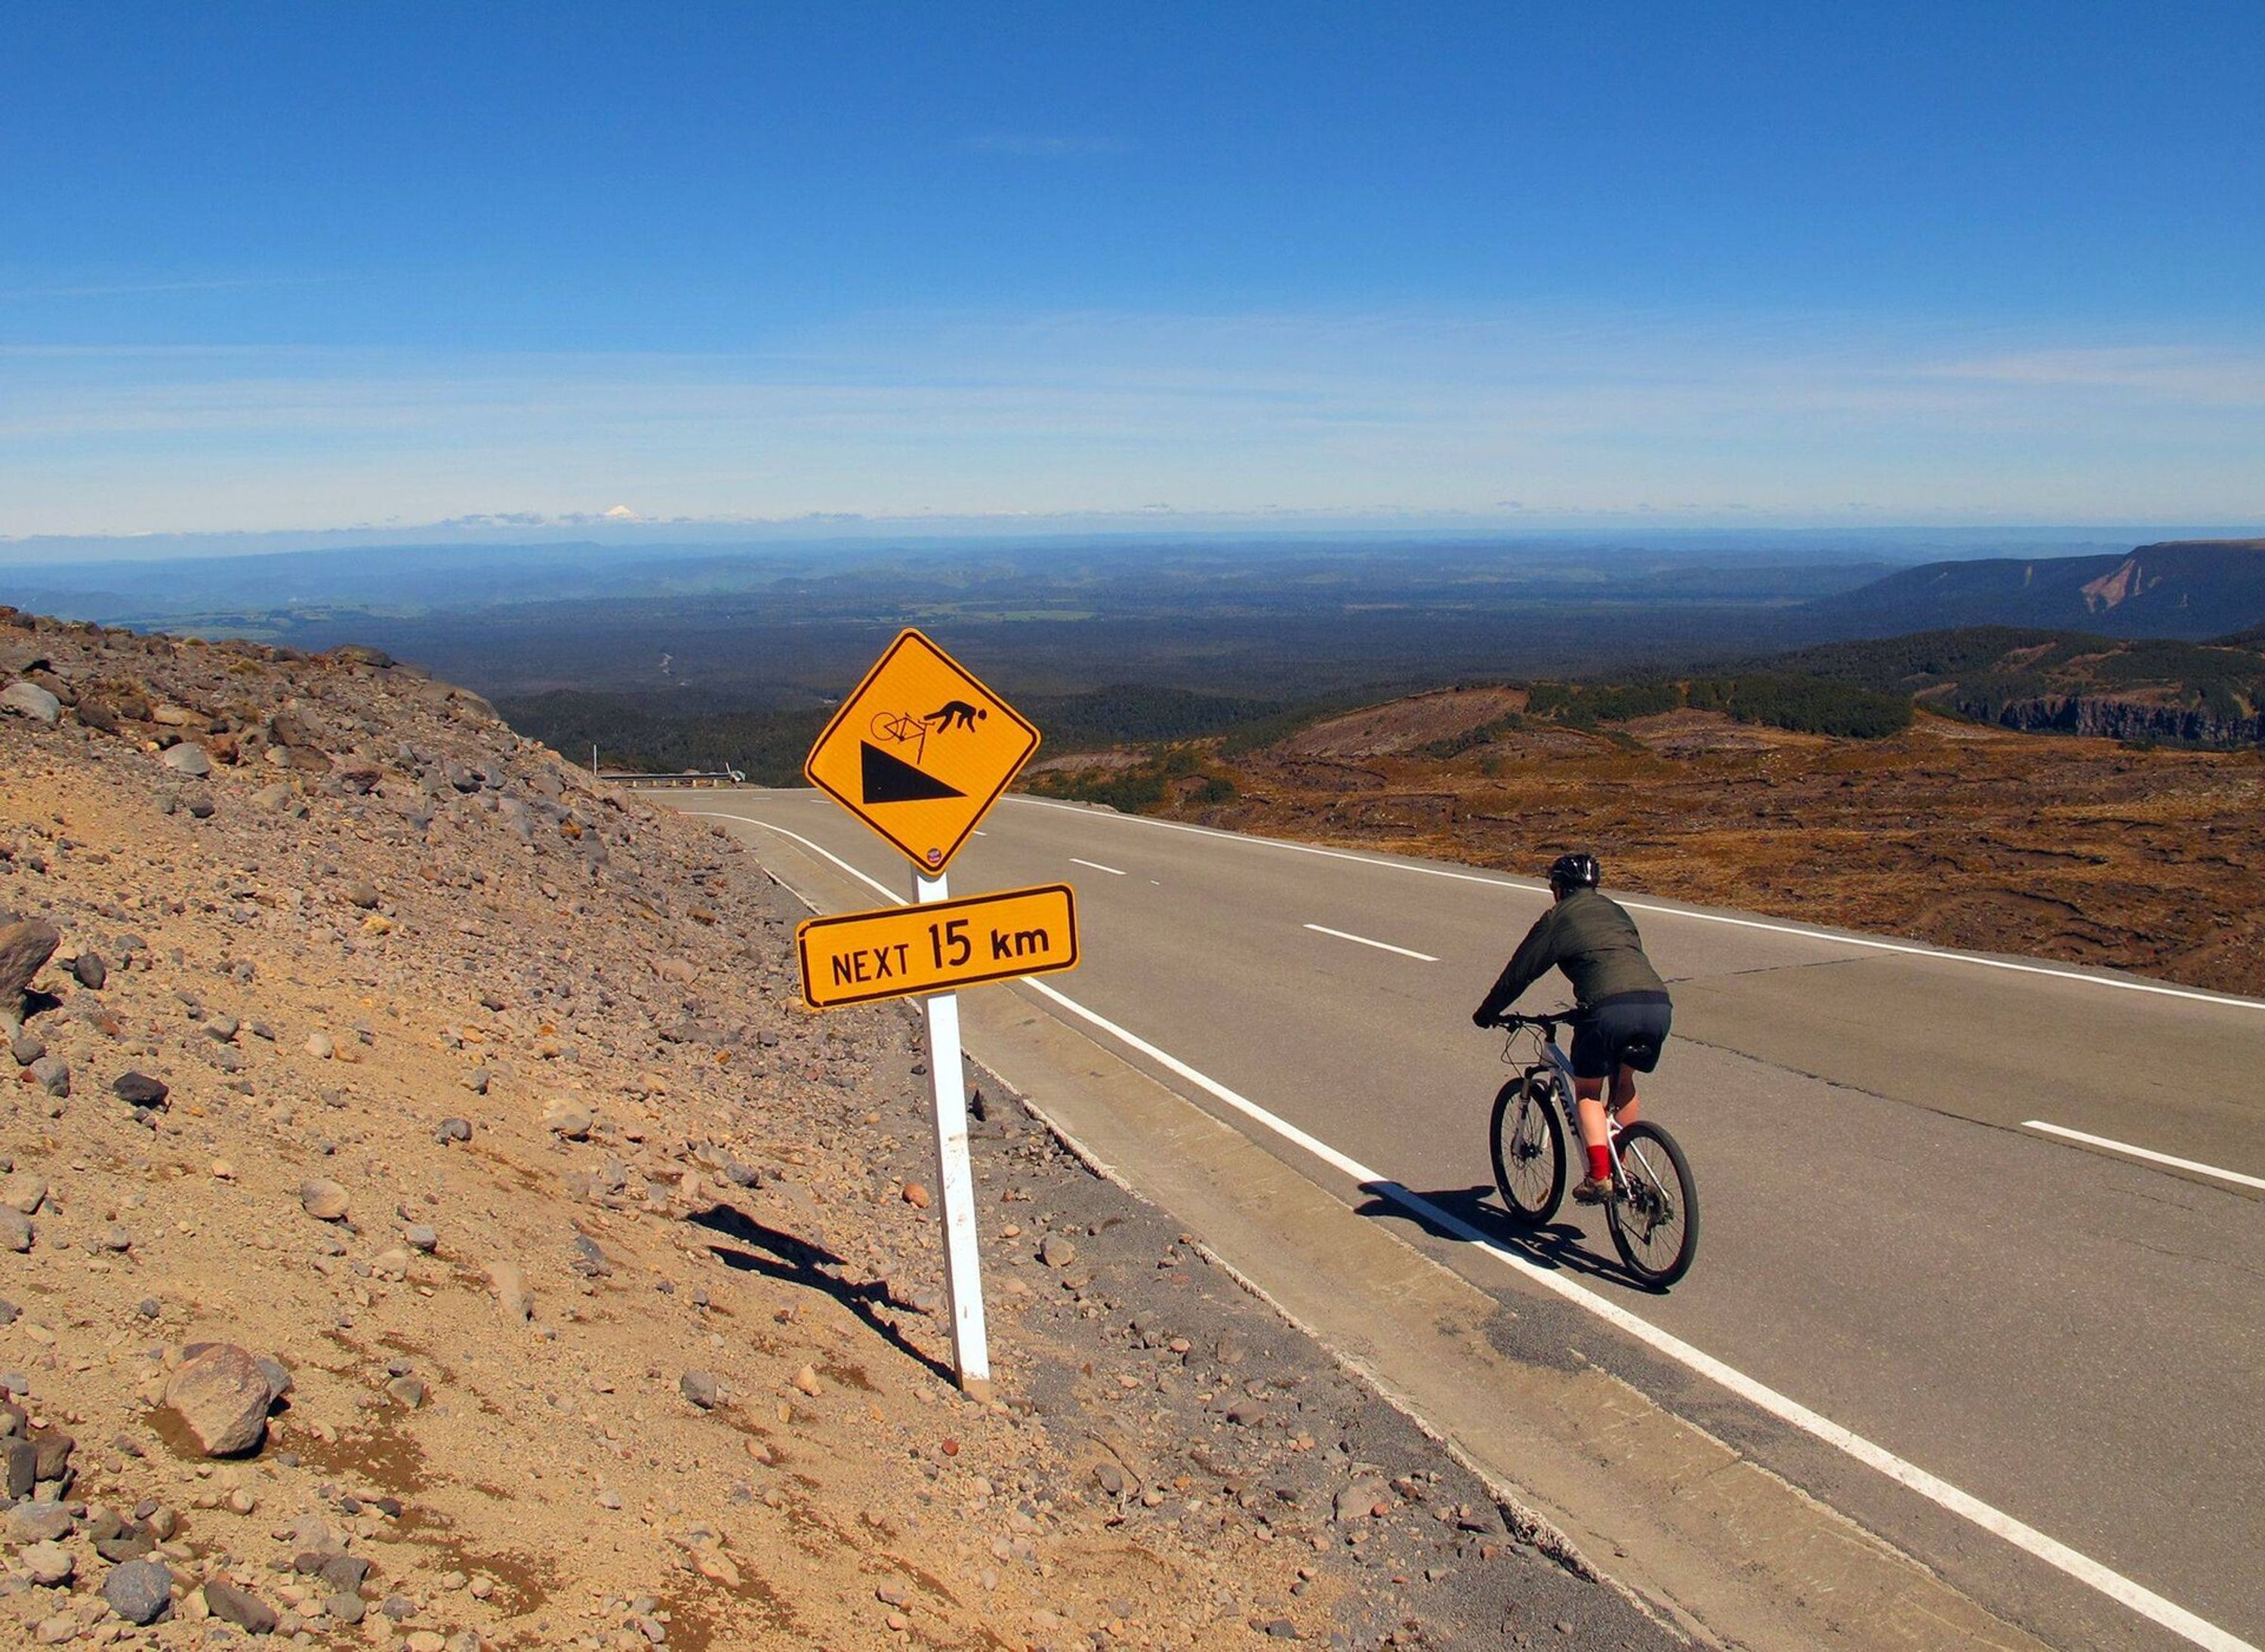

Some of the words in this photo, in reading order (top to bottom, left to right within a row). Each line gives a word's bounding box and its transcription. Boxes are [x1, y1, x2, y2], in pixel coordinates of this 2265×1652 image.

[831, 944, 909, 986] NEXT
[928, 918, 972, 969] 15
[991, 928, 1049, 960] km
[1550, 1076, 1582, 1139] GIANT
